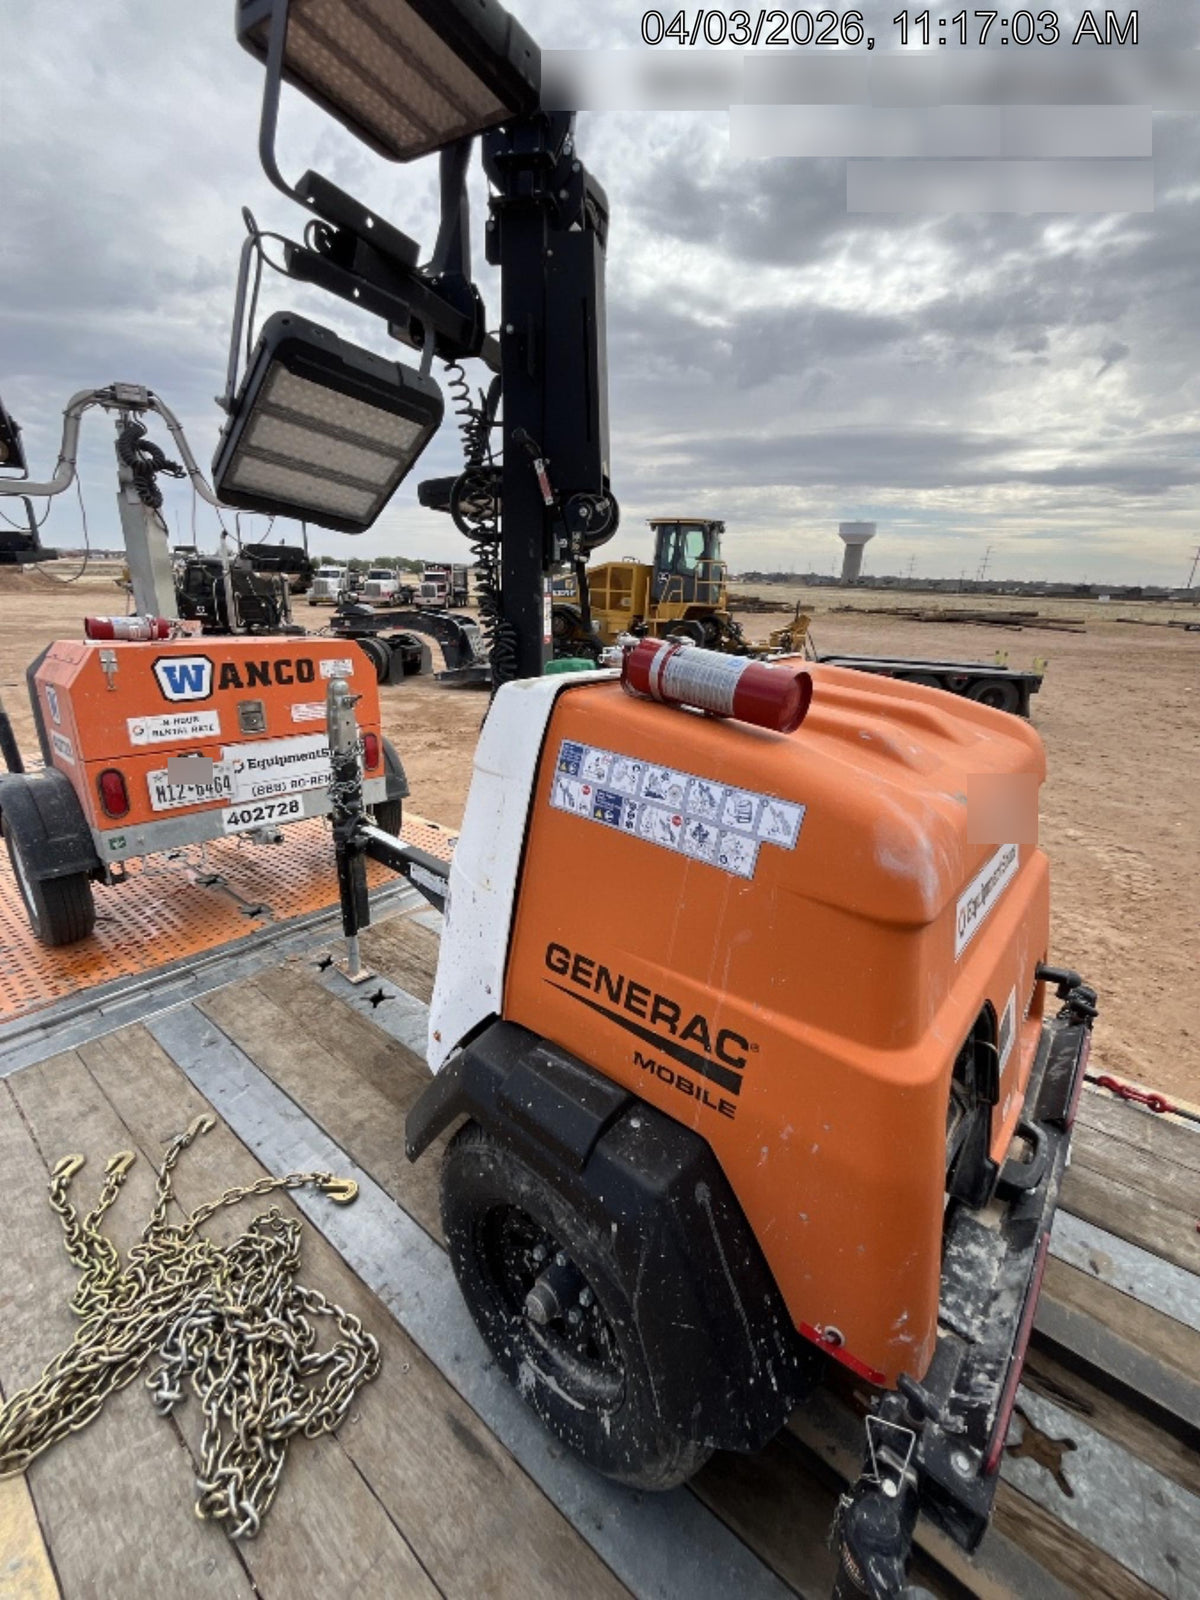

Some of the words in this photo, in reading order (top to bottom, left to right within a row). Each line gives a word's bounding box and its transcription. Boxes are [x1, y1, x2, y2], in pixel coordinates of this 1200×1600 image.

[161, 657, 315, 695] WANCO
[226, 799, 300, 827] 402728
[545, 941, 749, 1070] GENERAC
[633, 1051, 737, 1120] MOBILE
